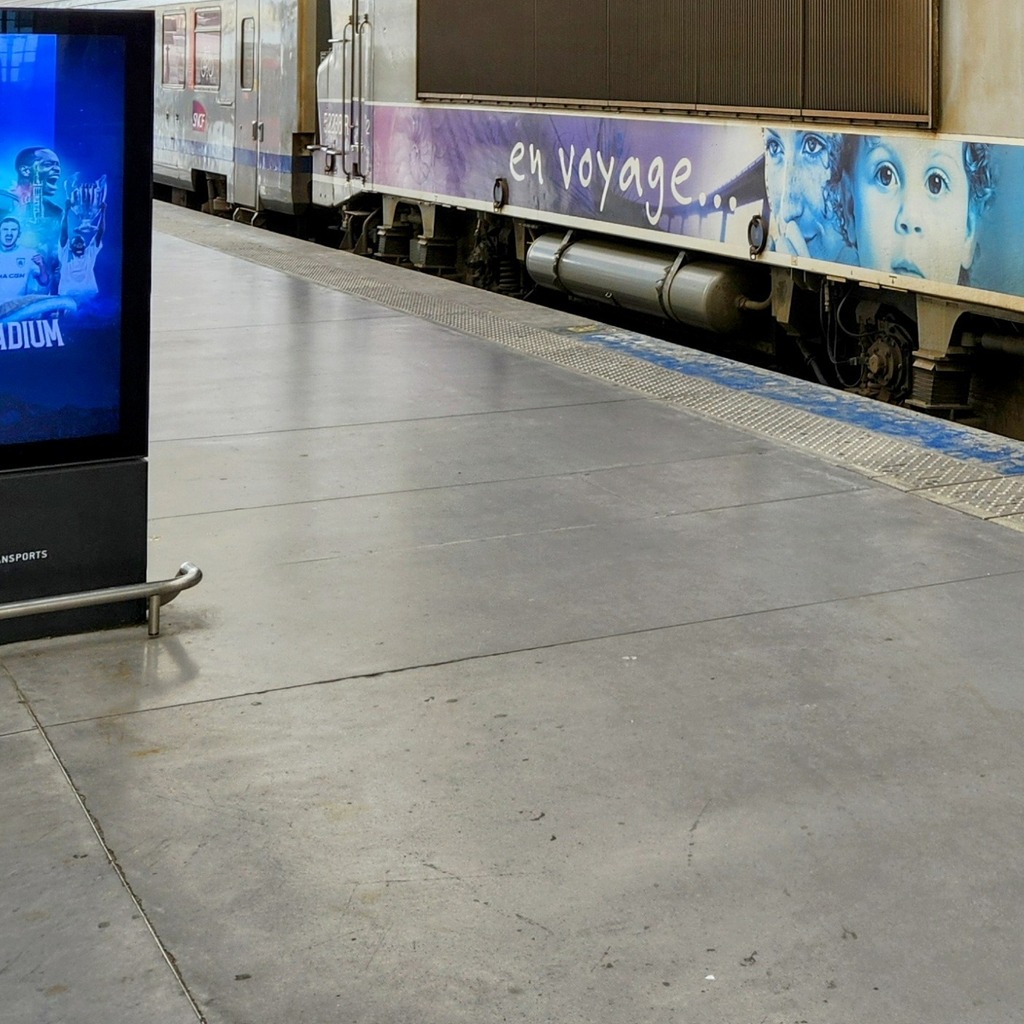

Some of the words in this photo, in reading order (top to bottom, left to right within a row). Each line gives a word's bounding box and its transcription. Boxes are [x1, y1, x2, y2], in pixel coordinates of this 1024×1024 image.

[509, 141, 544, 185] en
[558, 144, 737, 226] voyage...
[0, 549, 48, 564] NSPORTS
